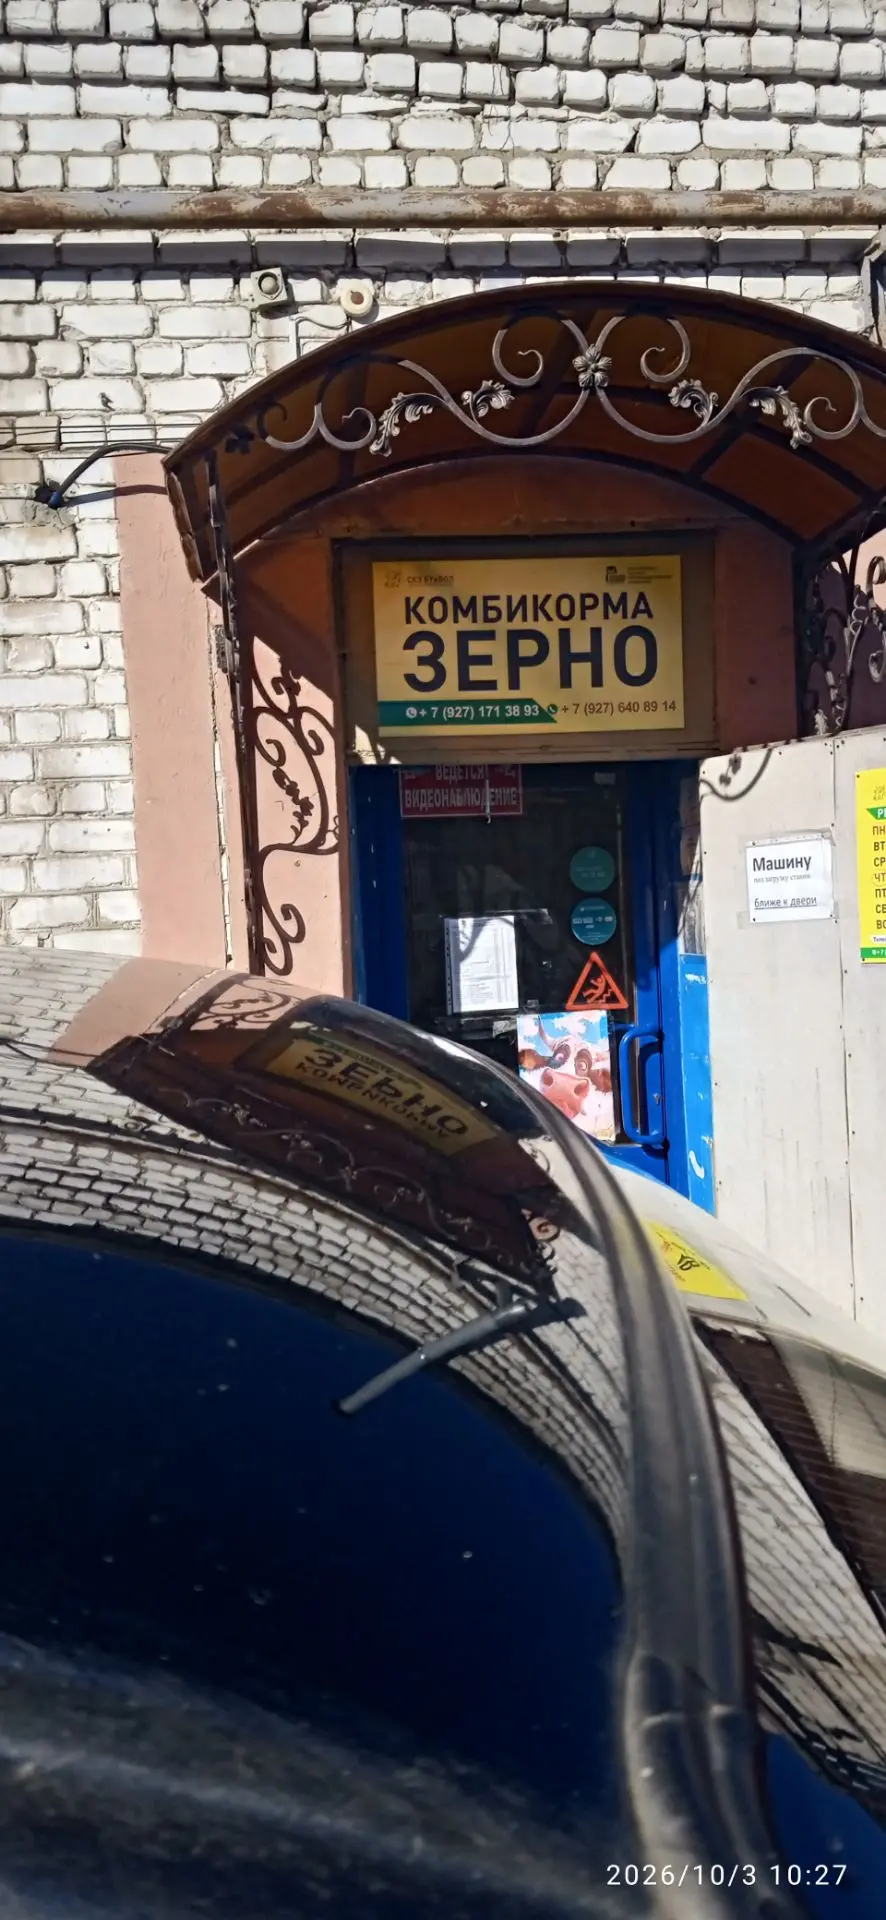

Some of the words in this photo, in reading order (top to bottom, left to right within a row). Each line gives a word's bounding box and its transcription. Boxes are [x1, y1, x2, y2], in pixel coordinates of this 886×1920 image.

[404, 591, 653, 625] КОМБИКОРМА
[402, 625, 658, 693] ЗЕРНО
[431, 706, 439, 718] 7
[443, 705, 474, 720] (927)
[479, 705, 501, 718] 171
[505, 705, 520, 717] 38
[523, 705, 540, 717] 93
[572, 703, 580, 714] 7
[584, 702, 614, 717] (927)
[618, 701, 639, 714] 640
[643, 701, 658, 713] 89
[662, 700, 677, 712] 14
[873, 825, 886, 836] ПН
[873, 841, 886, 852] ВТ
[752, 856, 812, 873] Машину
[873, 857, 886, 868] СР
[874, 873, 886, 883] ЧТ
[754, 898, 781, 909] ближе
[790, 896, 817, 908] двери
